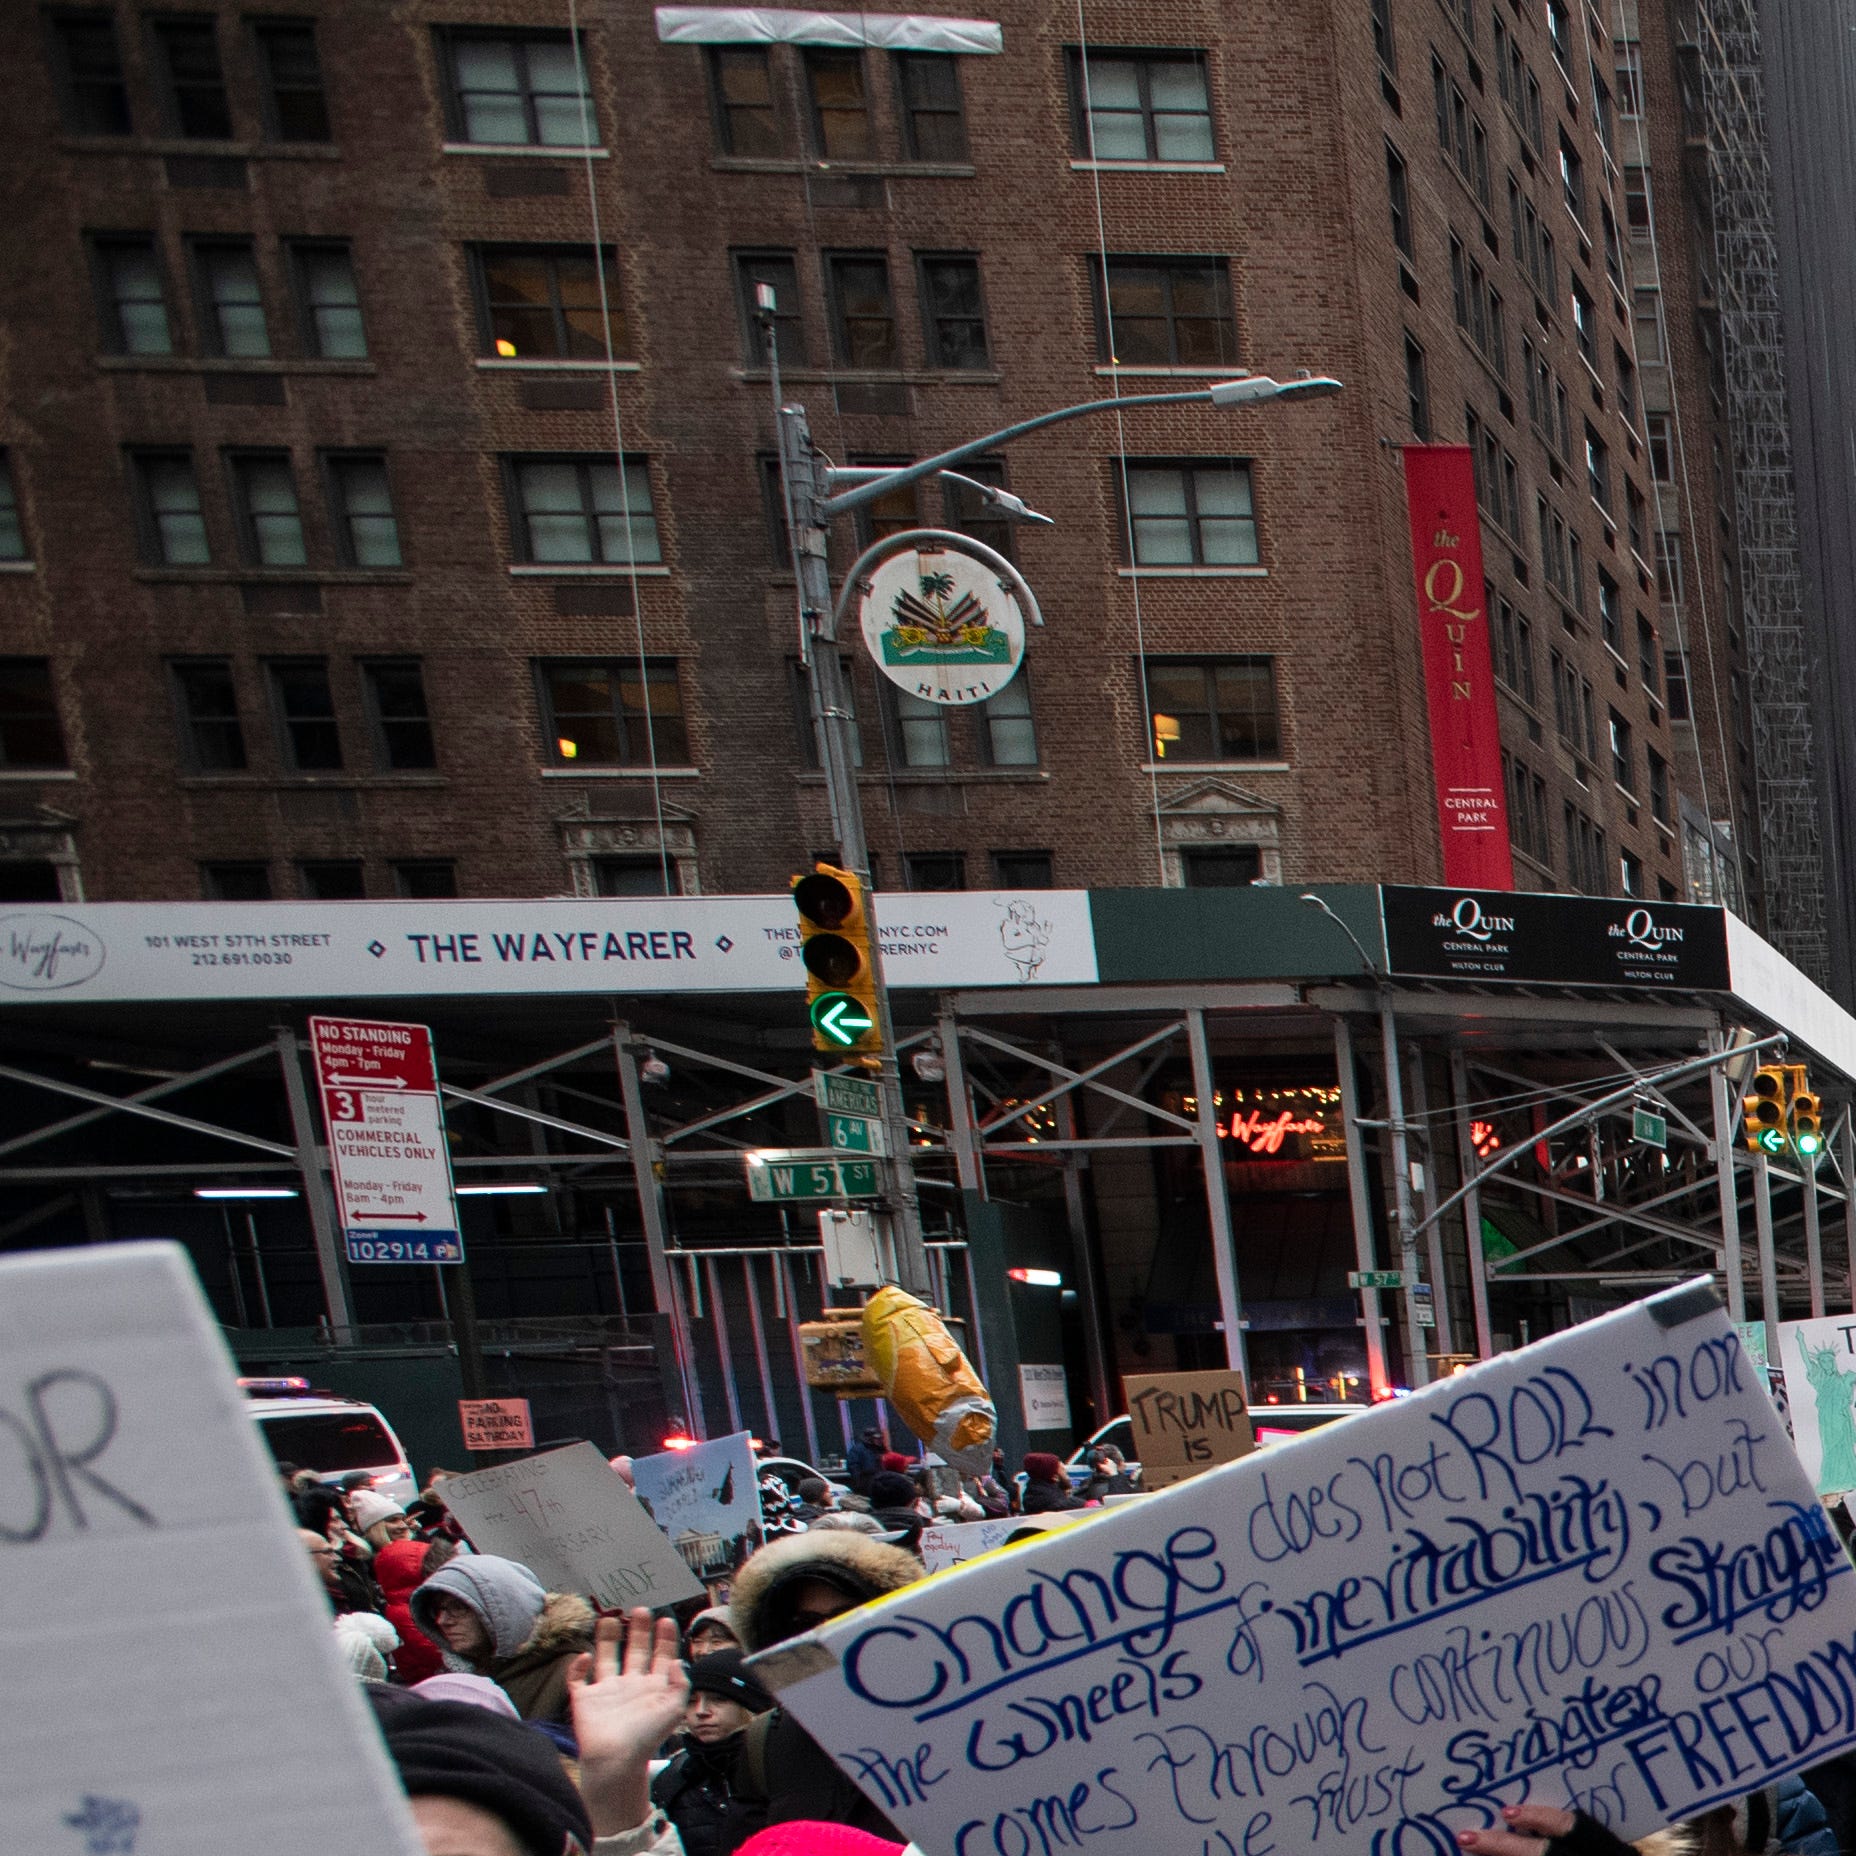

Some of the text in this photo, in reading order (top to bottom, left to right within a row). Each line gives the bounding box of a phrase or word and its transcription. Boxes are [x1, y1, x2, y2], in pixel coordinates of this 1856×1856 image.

[1432, 528, 1460, 548] the
[917, 682, 990, 701] HAITI
[1444, 797, 1499, 810] CENTRAL
[1457, 811, 1488, 823] PARK
[1433, 912, 1453, 928] the
[1608, 923, 1626, 938] the
[174, 933, 332, 949] WEST 57TH STREET
[408, 931, 697, 963] THE WAYFARER
[1443, 942, 1509, 953] CENTRAL PARK
[192, 952, 293, 967] 212.691.0030
[1616, 951, 1679, 962] CENTRAL PARK
[319, 1024, 412, 1045] NO STANDING
[321, 1042, 406, 1061] Monday Friday
[334, 1091, 356, 1120] 3
[336, 1129, 421, 1144] COMMERCIAL
[834, 1119, 848, 1147] 6
[339, 1145, 436, 1160] VEHICLES ONLY
[773, 1165, 870, 1195] W ST
[350, 1242, 429, 1260] 102914
[1130, 1386, 1245, 1435] TRUMP
[1183, 1435, 1213, 1462] is
[842, 1353, 1690, 1708] Change does not ROLL in
[839, 1417, 1772, 1809] the but
[1694, 1626, 1785, 1694] our
